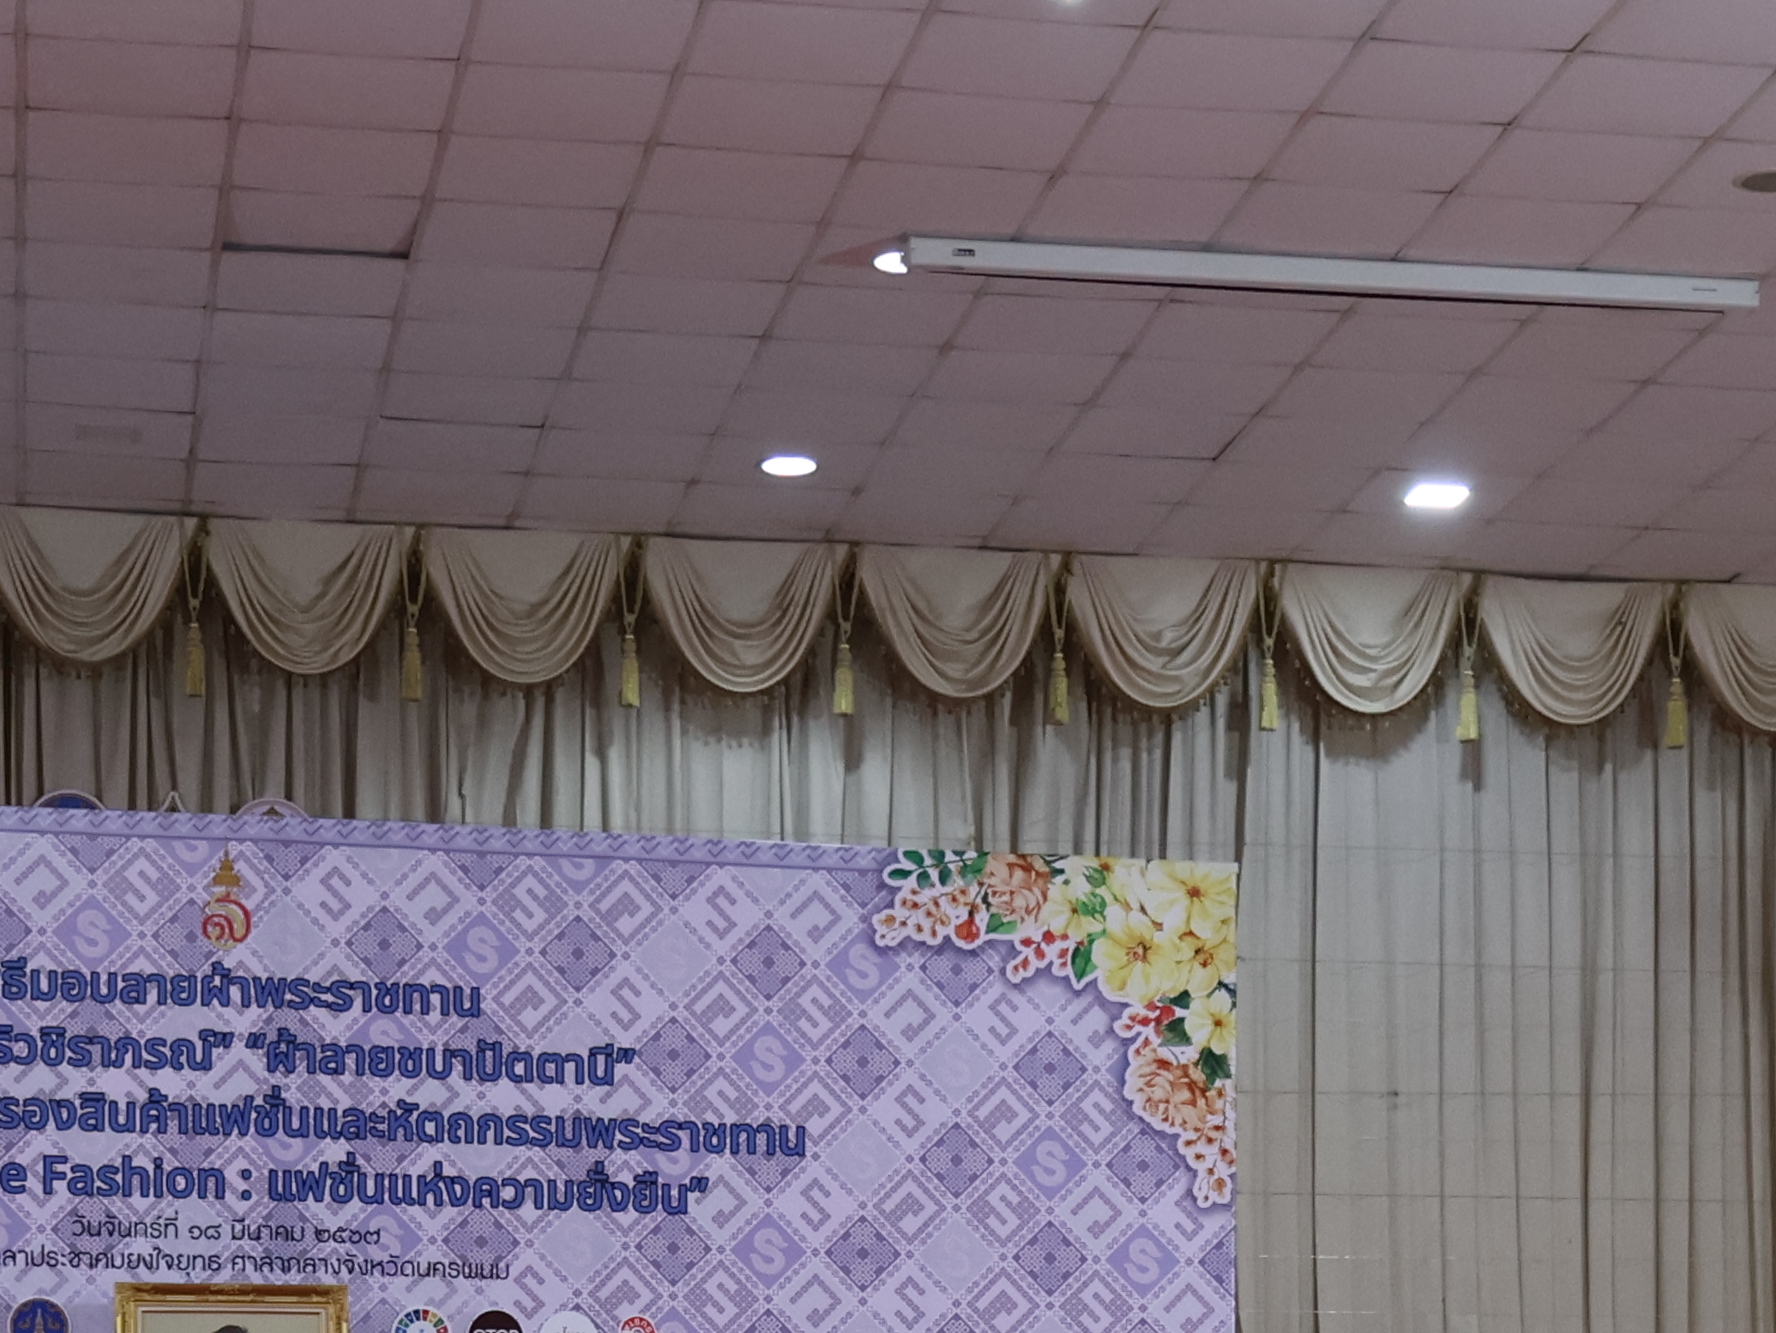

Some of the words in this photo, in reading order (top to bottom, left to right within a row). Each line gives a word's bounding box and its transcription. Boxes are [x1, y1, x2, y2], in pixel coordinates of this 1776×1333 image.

[42, 1154, 225, 1200] Fashion
[71, 1210, 180, 1241] วันจันทร์ที่
[188, 1223, 222, 1241] ๑๘
[230, 1218, 305, 1243] มีนาคม
[314, 1226, 381, 1245] ๒๕๖๗
[230, 1252, 510, 1281] ศาลากลางจังหวัดนครพนม
